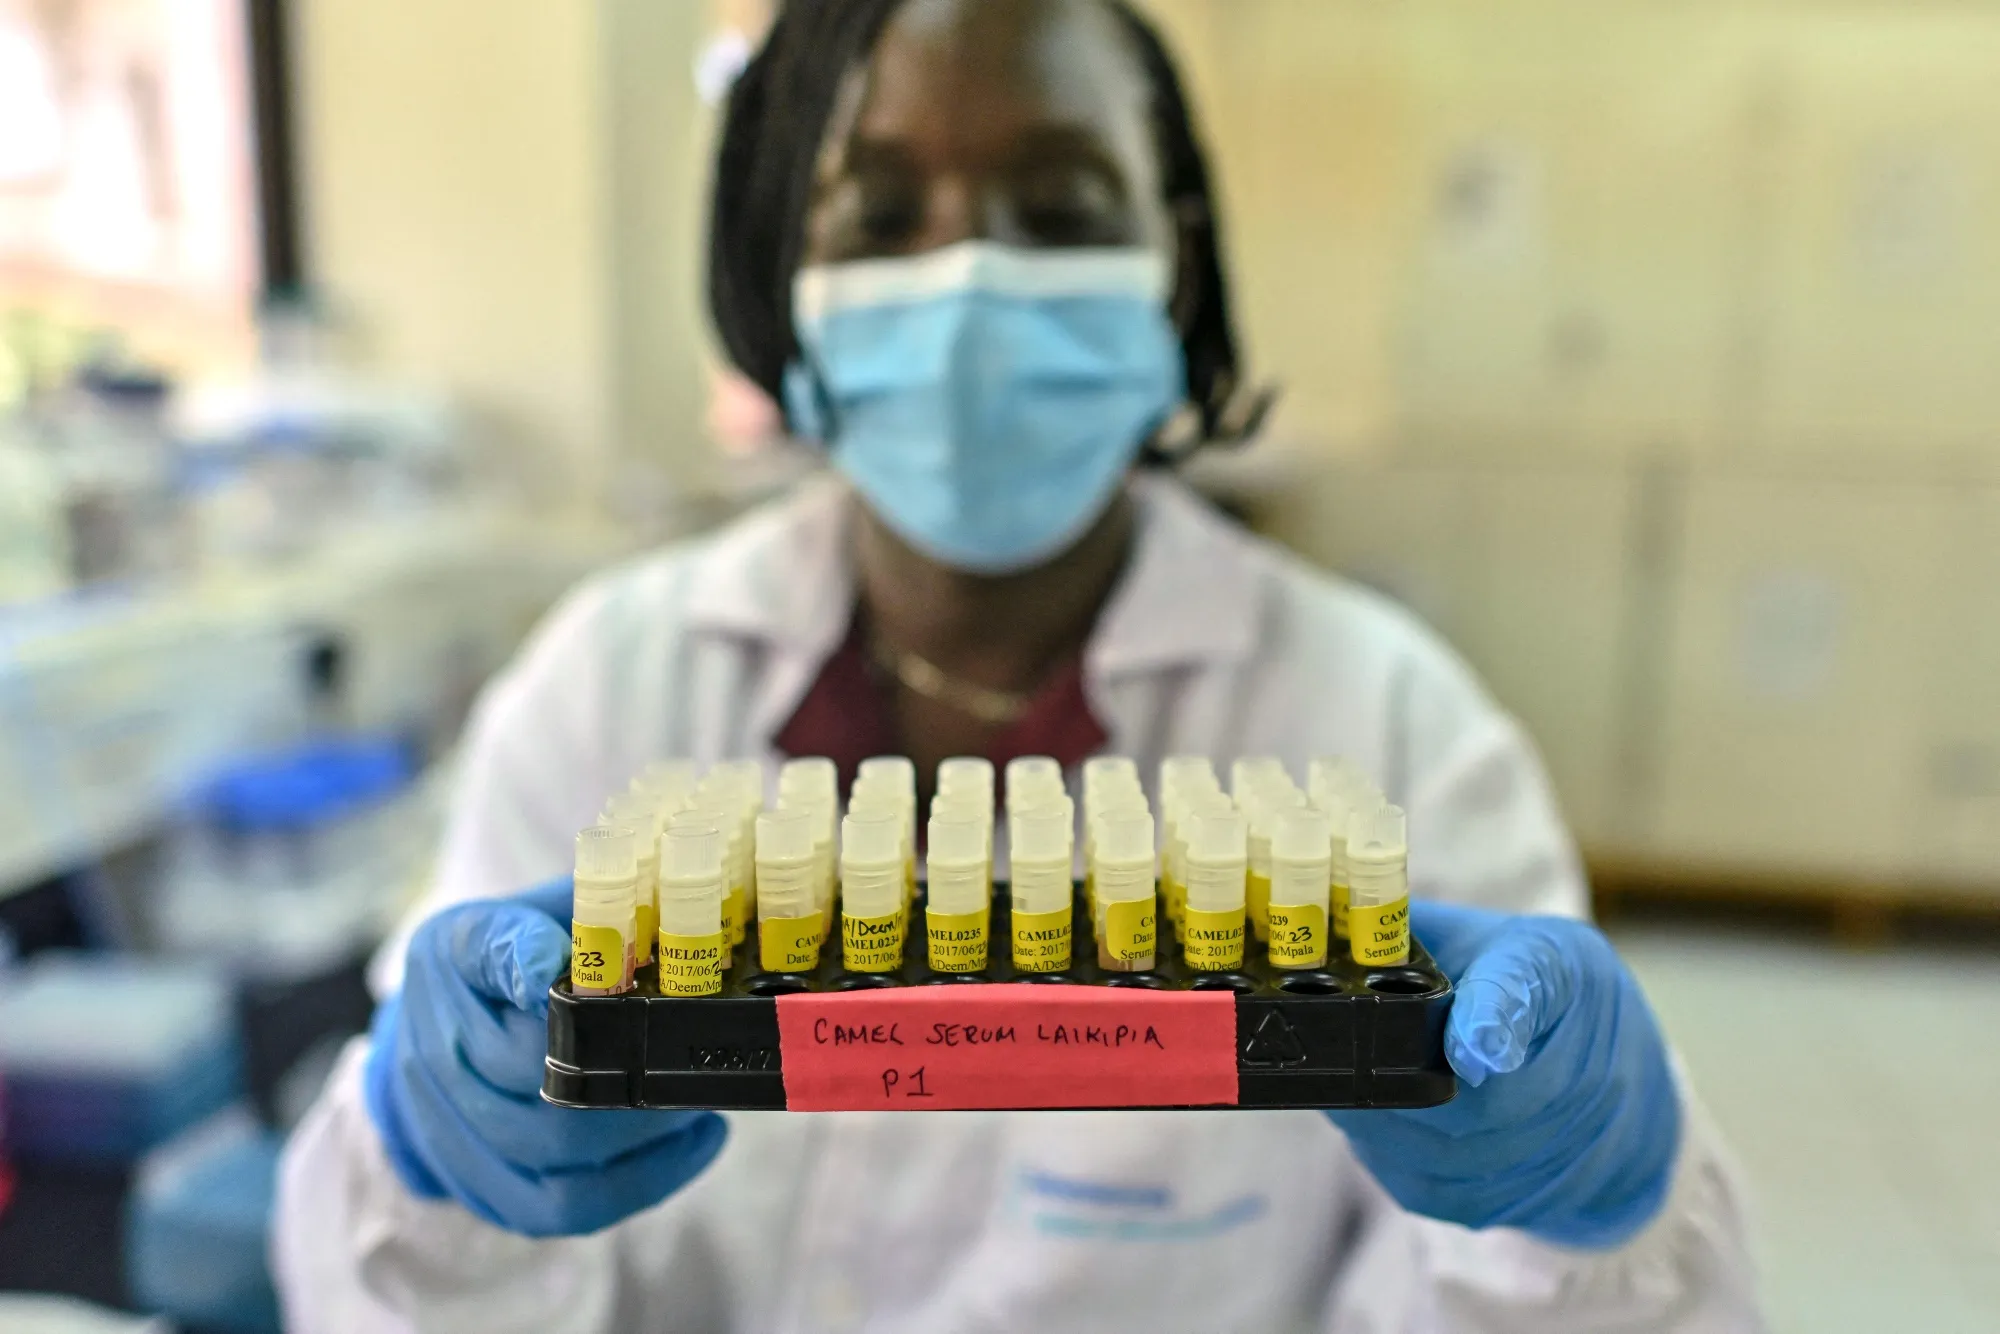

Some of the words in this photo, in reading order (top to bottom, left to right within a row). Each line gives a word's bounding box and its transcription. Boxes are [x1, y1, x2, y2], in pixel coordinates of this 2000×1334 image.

[813, 1018, 904, 1047] CAMEL
[926, 1023, 1016, 1047] SERUM
[882, 1066, 933, 1098] P1
